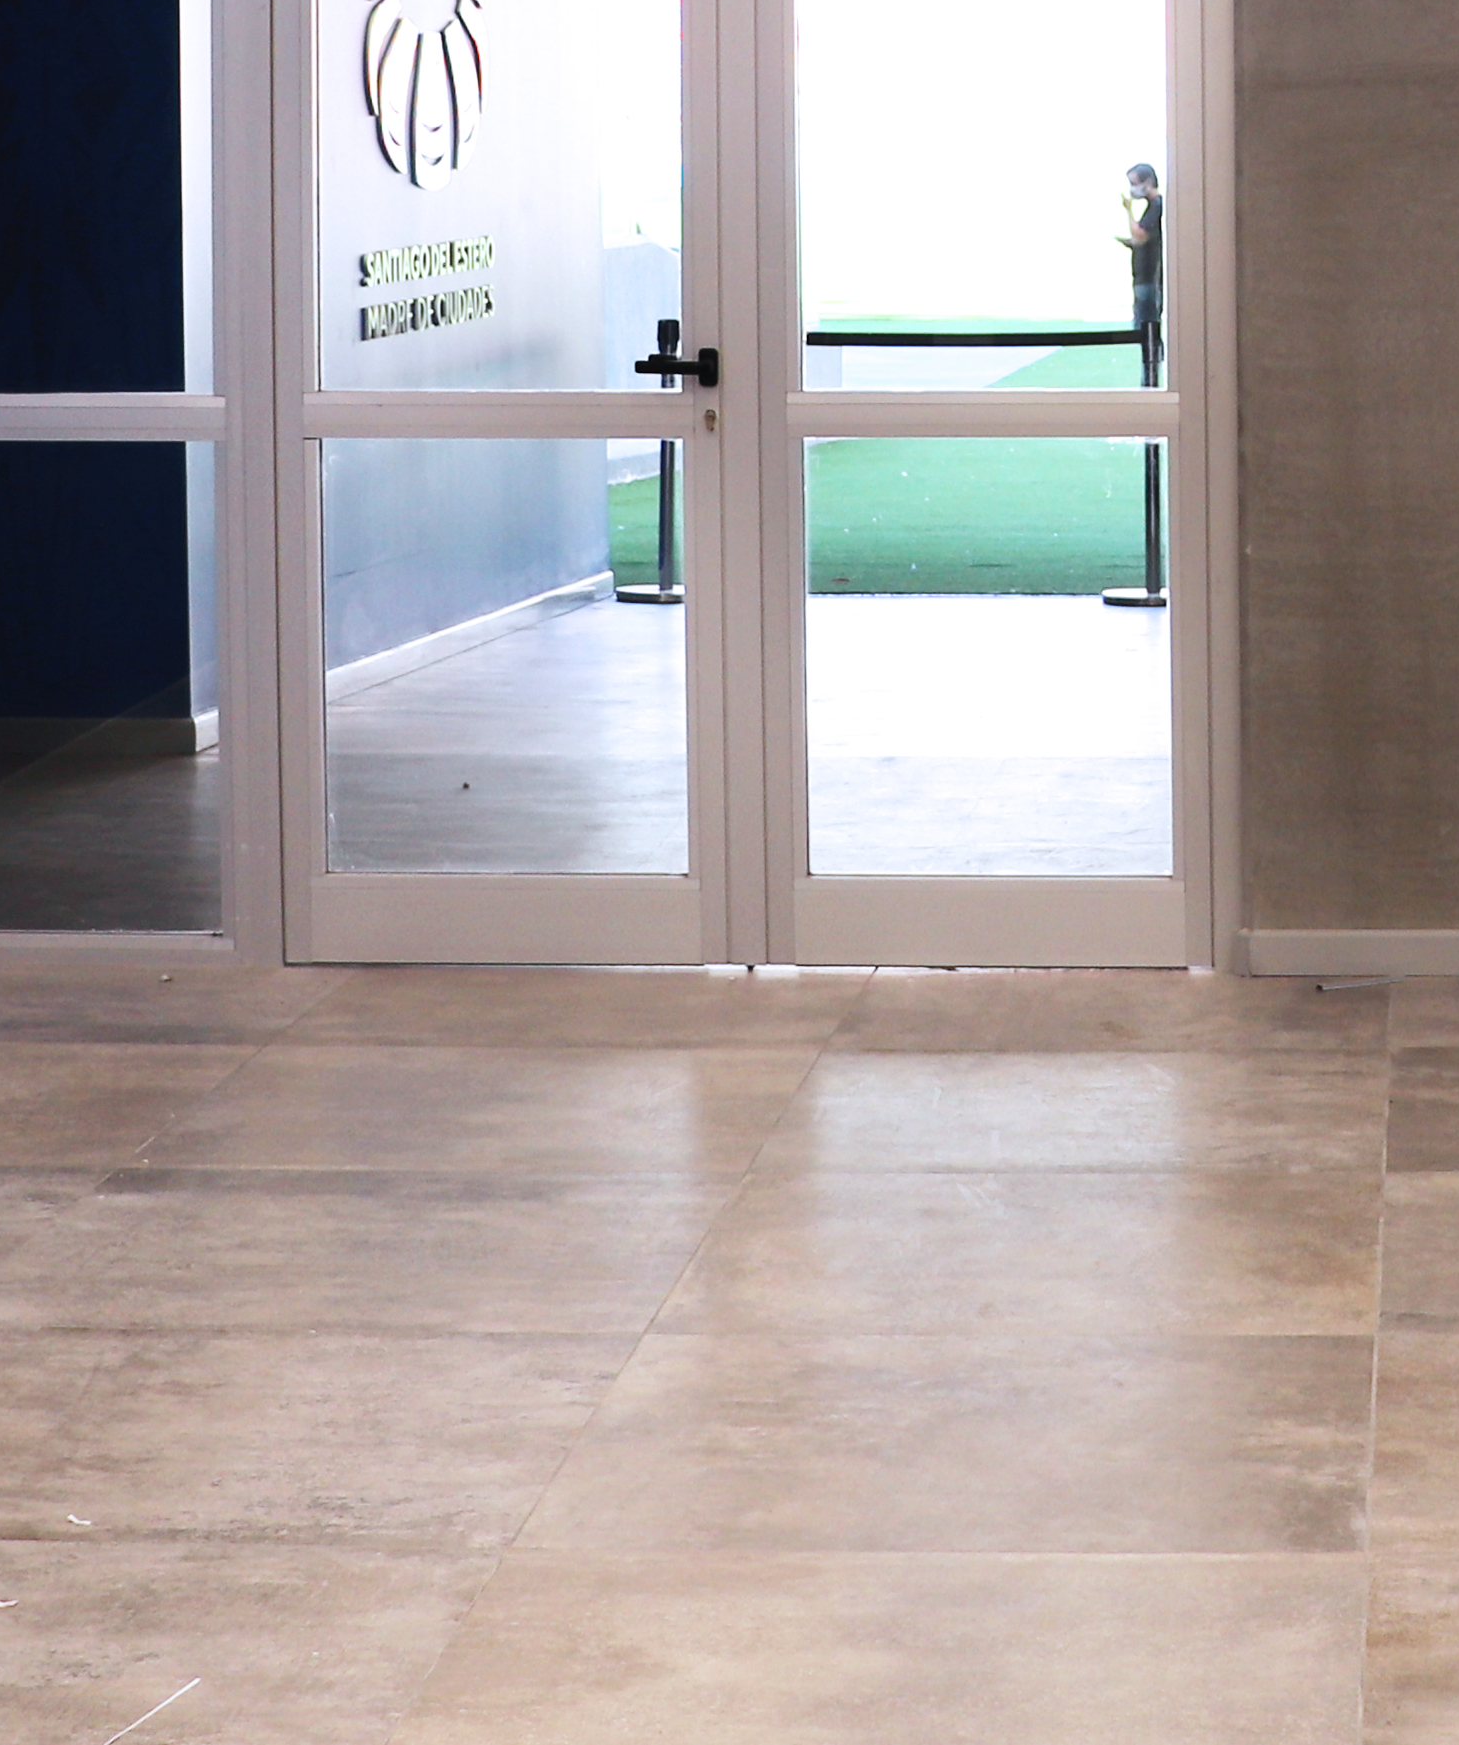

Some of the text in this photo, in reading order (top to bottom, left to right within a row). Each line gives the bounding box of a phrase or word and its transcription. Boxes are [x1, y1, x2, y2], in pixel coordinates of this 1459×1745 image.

[360, 235, 496, 287] SANTIAGO DEL ESTERO
[437, 284, 496, 328] CIUDADES
